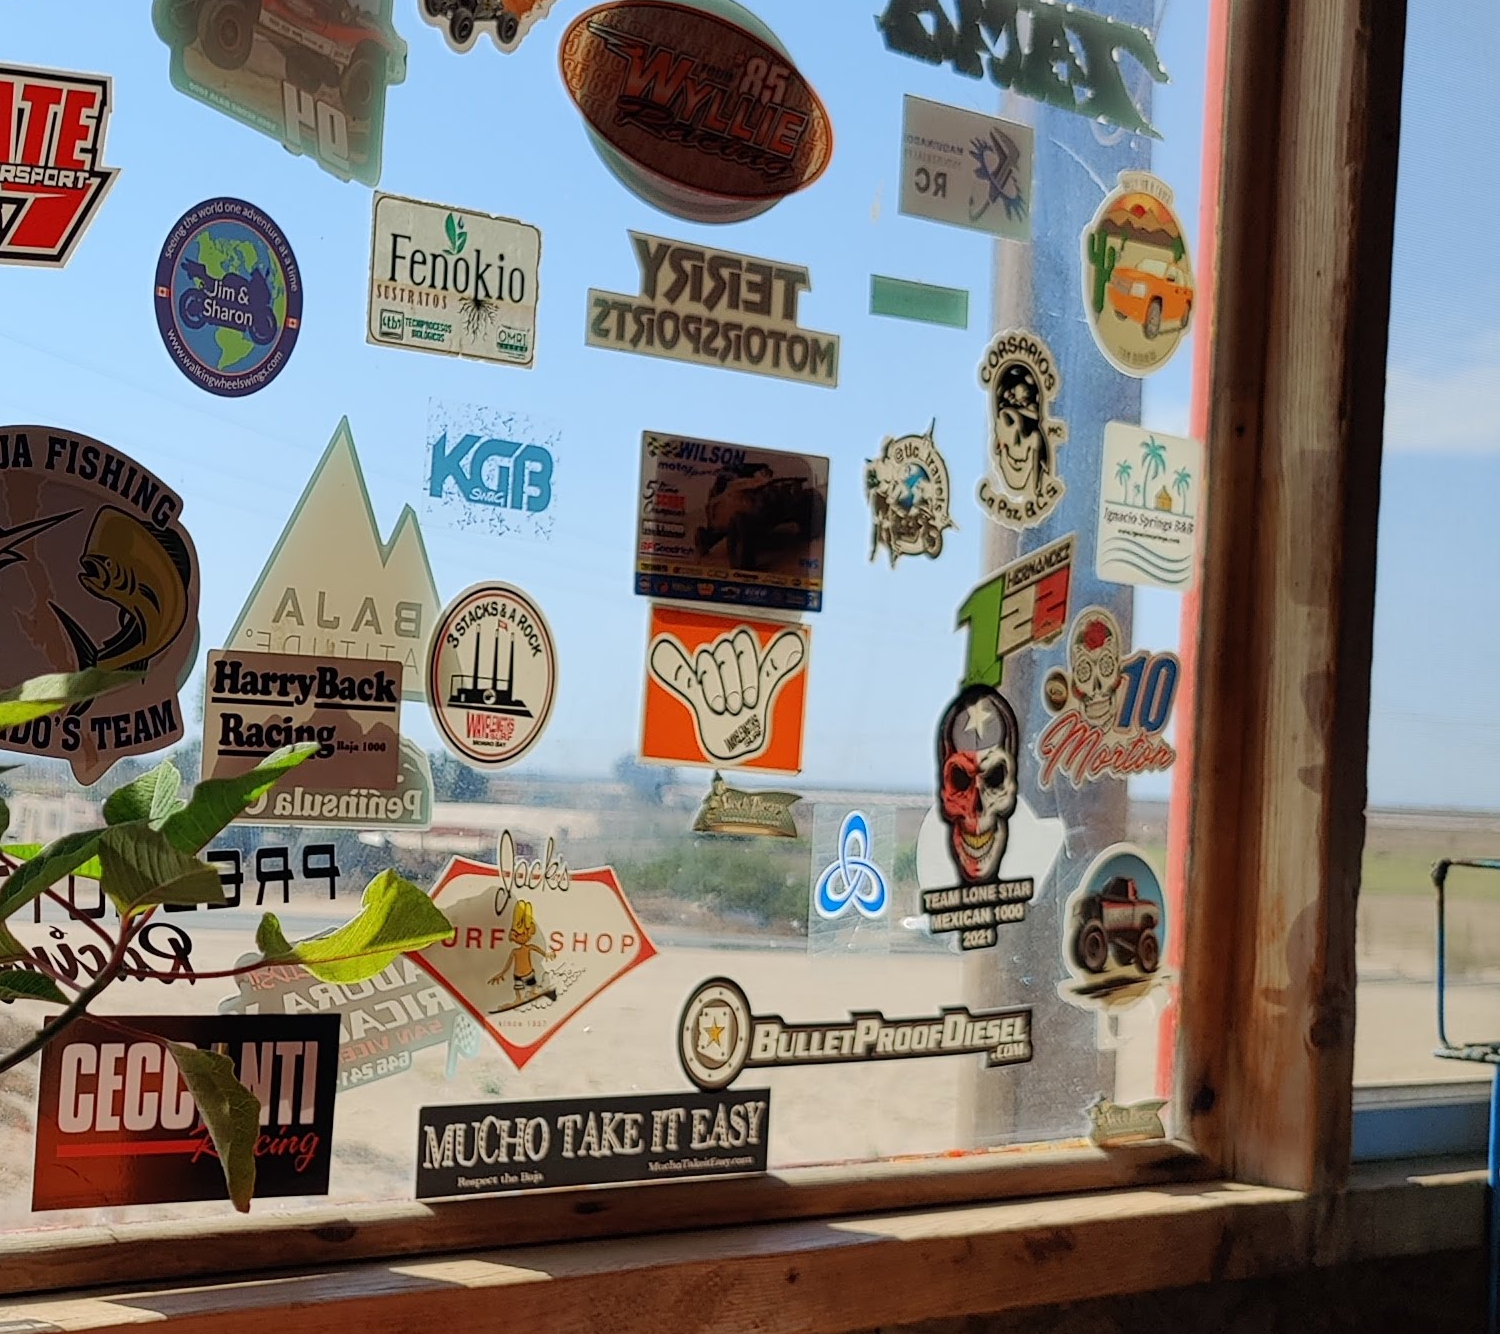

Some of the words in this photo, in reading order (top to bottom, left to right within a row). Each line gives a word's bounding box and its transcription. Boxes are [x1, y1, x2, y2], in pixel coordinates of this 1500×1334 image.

[618, 39, 810, 160] WYLLIE
[164, 226, 187, 259] seeing
[184, 211, 199, 234] the
[198, 201, 224, 221] world
[224, 203, 242, 215] one
[241, 205, 282, 244] adventure
[278, 243, 289, 257] at
[286, 265, 298, 293] time
[388, 231, 526, 304] Fenokio
[203, 298, 254, 327] Sharon
[205, 280, 236, 303] Jim
[237, 286, 250, 306] &
[980, 336, 1056, 392] CORSARIOS
[428, 430, 554, 514] KGB
[678, 441, 747, 465] WILSON
[44, 435, 178, 531] FISHING
[1005, 545, 1072, 590] HERNANDEZ
[446, 632, 460, 649] 3
[455, 600, 499, 638] STACKS
[499, 603, 507, 618] &
[507, 607, 517, 624] A
[517, 614, 543, 658] ROCK
[212, 659, 397, 706] HarryBack
[1115, 653, 1178, 734] 10
[90, 699, 179, 751] TEAM
[218, 711, 336, 760] Racing
[336, 740, 360, 754] Baja
[362, 741, 387, 753] 1000
[493, 828, 571, 917] Jack's
[923, 889, 962, 911] TEAM
[962, 884, 997, 905] LONE
[998, 880, 1033, 900] STAR
[931, 908, 992, 931] MEXICAN
[993, 902, 1024, 923] 1000
[962, 929, 995, 949] 2021
[549, 930, 636, 955] SHOP
[422, 1114, 551, 1170] MUCHO
[557, 1110, 646, 1160] TAKE
[651, 1106, 688, 1154] IT
[690, 1100, 766, 1151] EASY
[457, 1172, 498, 1189] Respect
[500, 1171, 519, 1186] the
[520, 1170, 546, 1186] Baja
